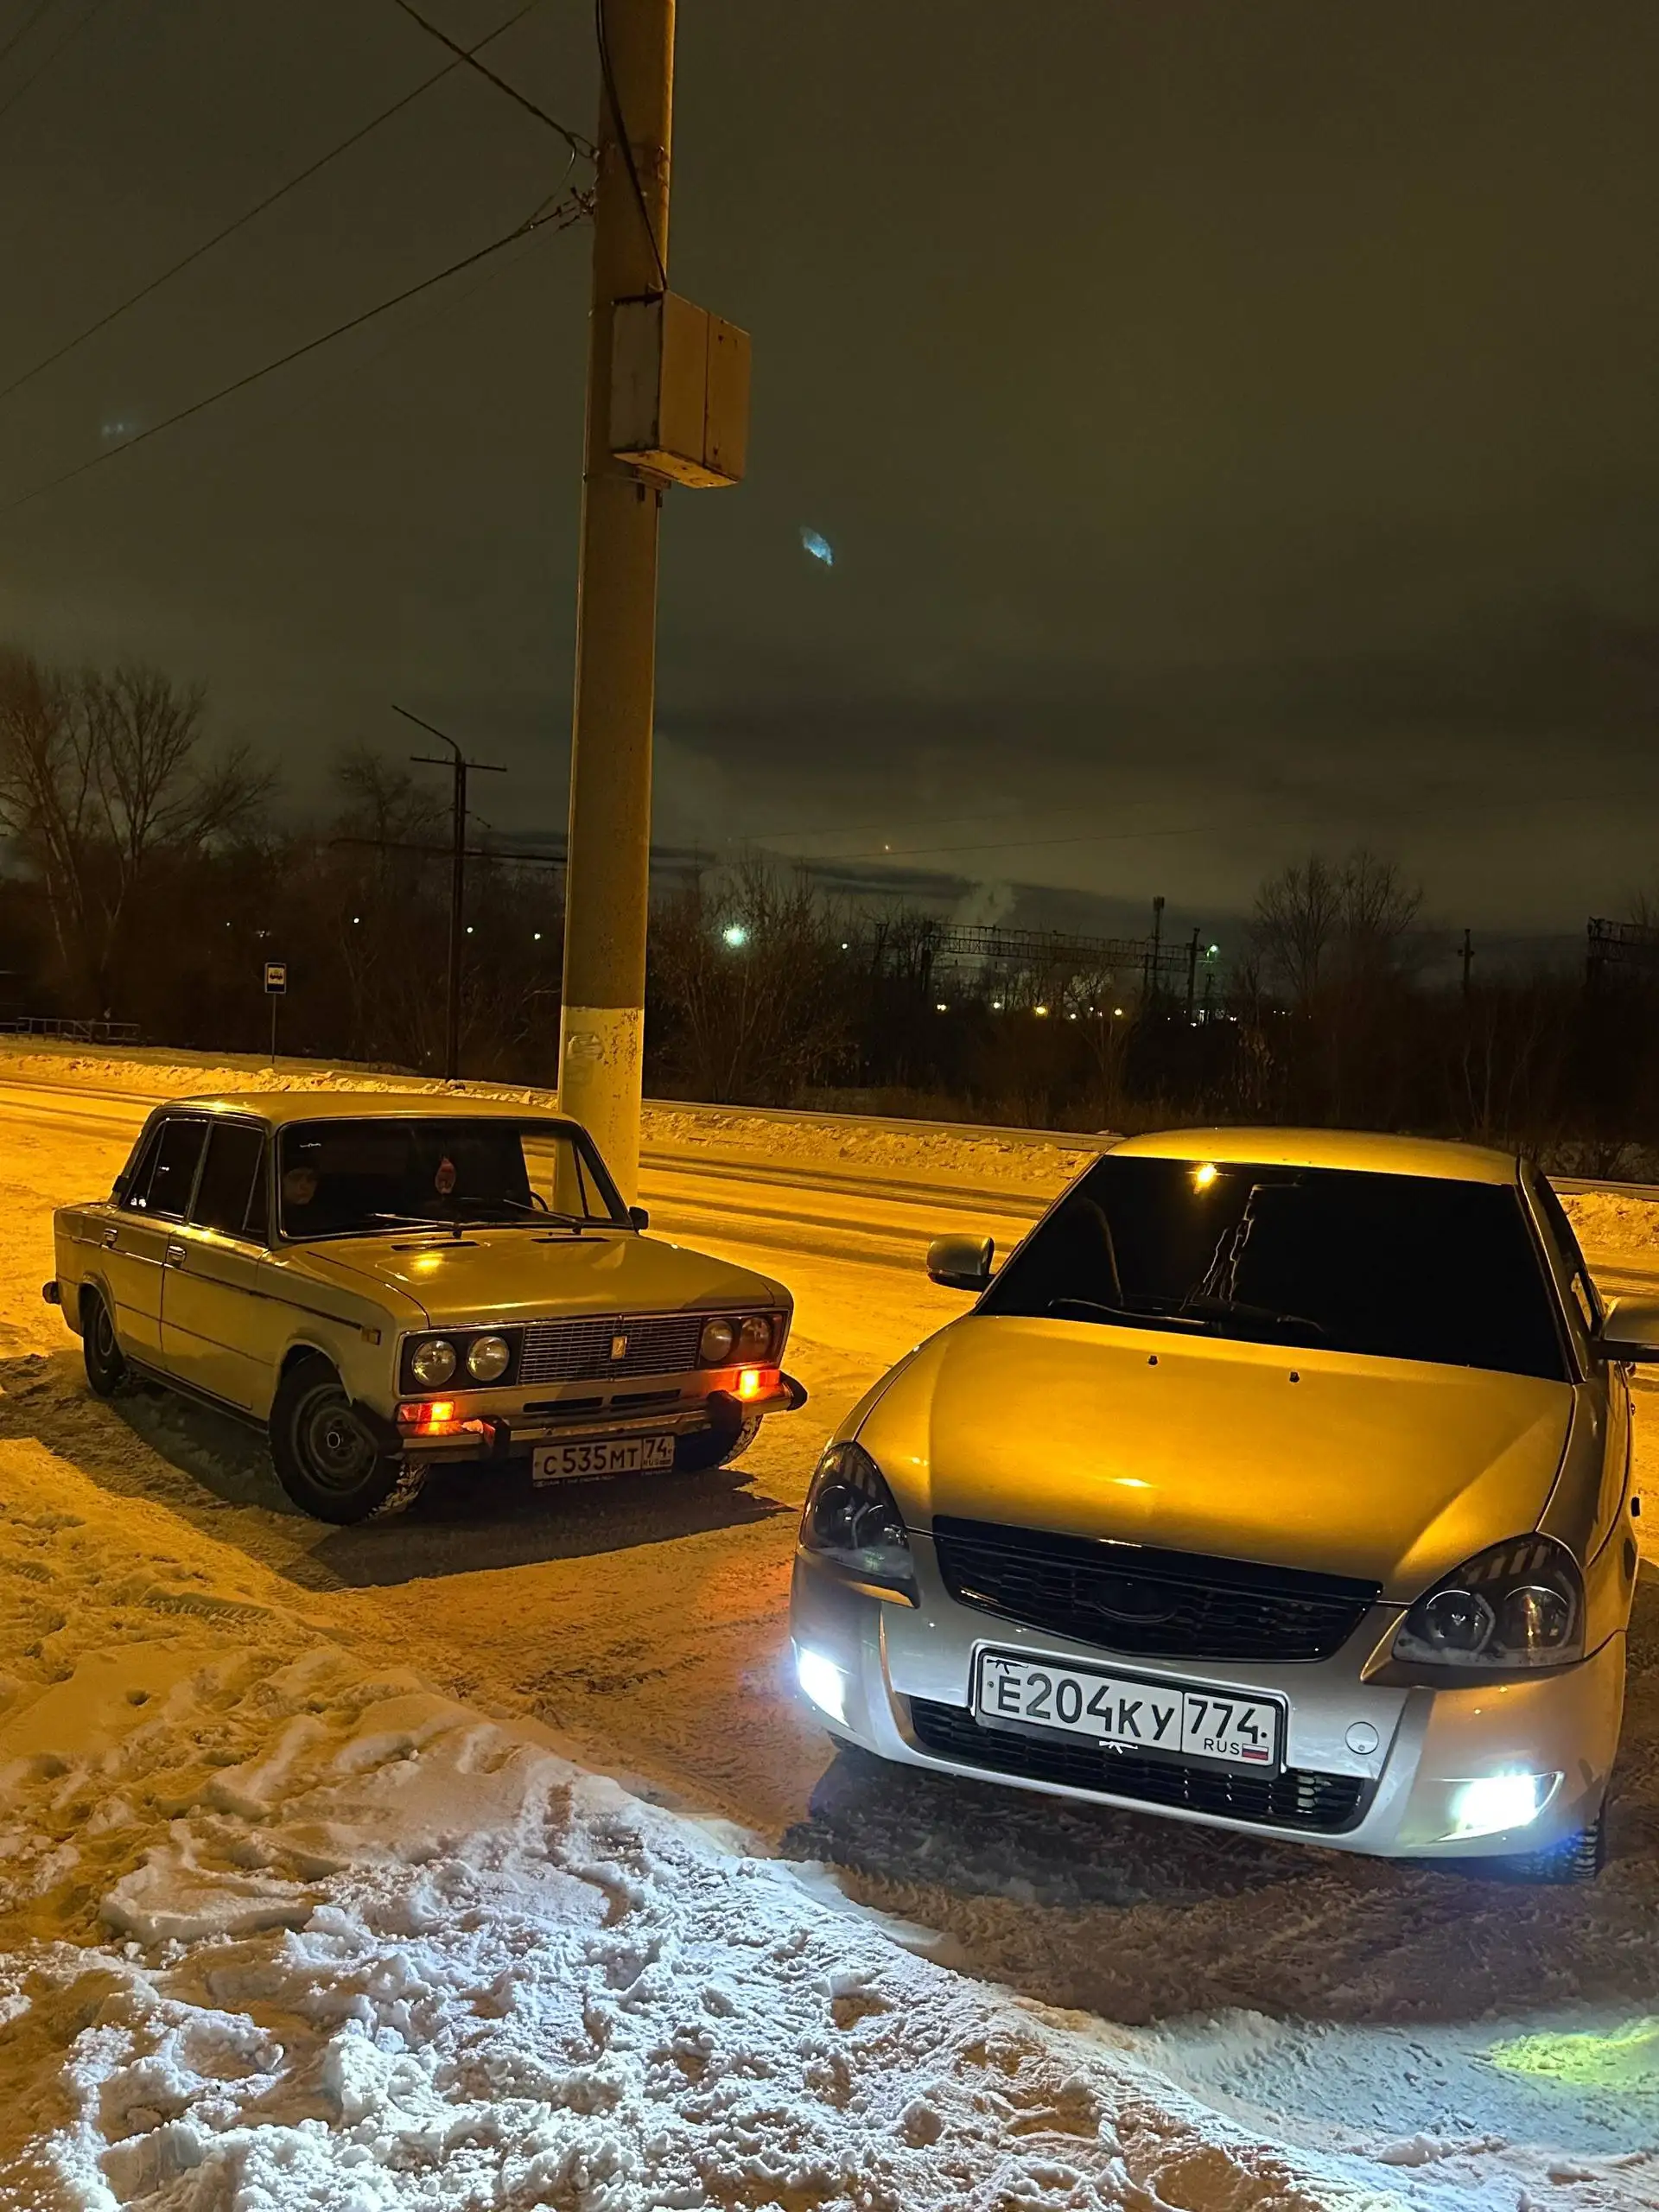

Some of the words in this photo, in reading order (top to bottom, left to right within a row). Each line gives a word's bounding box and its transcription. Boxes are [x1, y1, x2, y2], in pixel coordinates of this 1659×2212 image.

[543, 1445, 639, 1476] С535МТ
[645, 1438, 667, 1459] 74
[997, 1673, 1175, 1741] Е204КУ
[1188, 1699, 1259, 1745] 774
[1204, 1738, 1240, 1756] RUS
